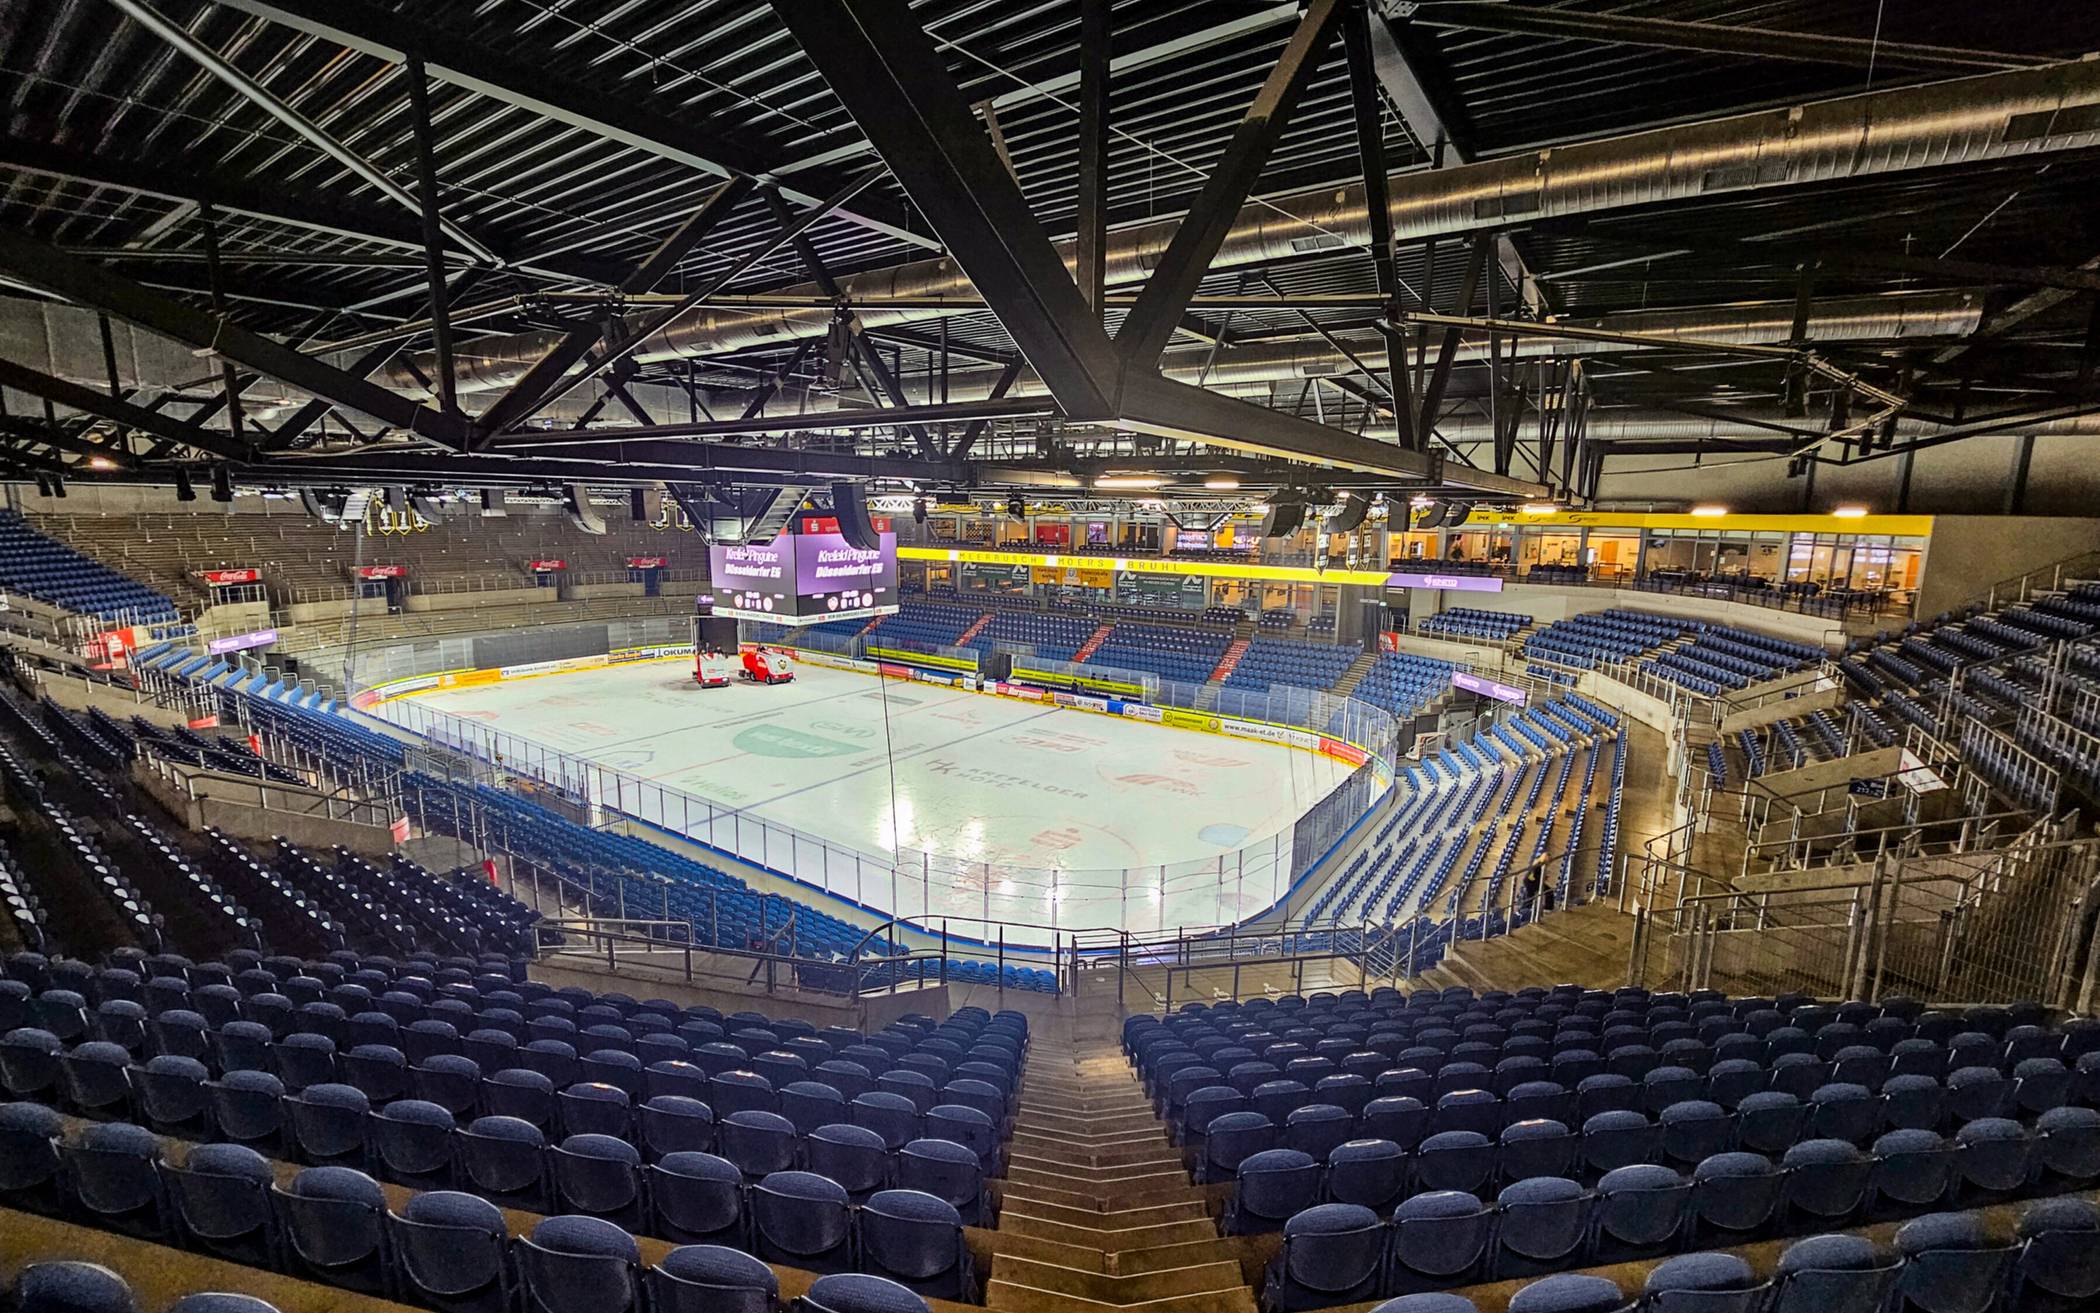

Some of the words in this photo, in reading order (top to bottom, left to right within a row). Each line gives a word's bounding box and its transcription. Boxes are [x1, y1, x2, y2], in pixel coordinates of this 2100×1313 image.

[818, 549, 848, 563] Krefeld
[1057, 557, 1105, 567] MOERS
[219, 571, 248, 582] Coca-Cola
[1224, 723, 1275, 737] www.maak-et.de
[969, 768, 1089, 799] KREFELDER
